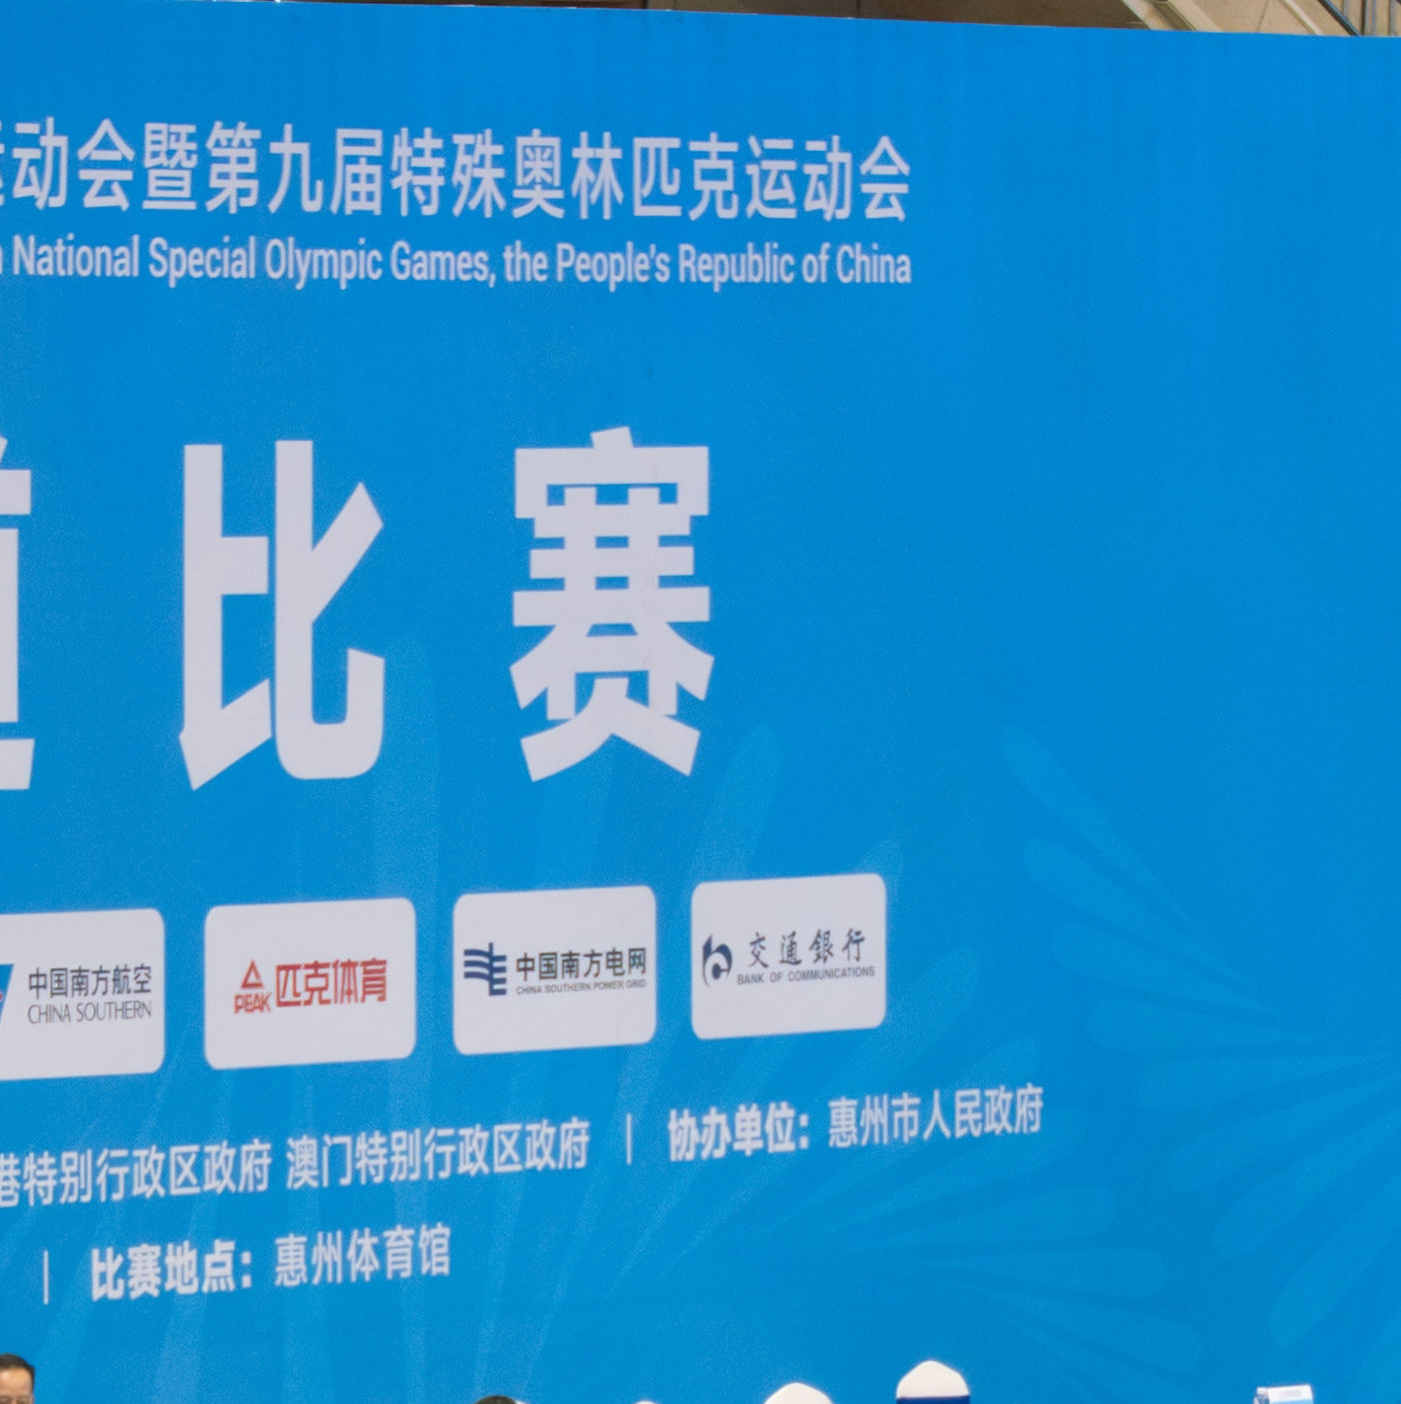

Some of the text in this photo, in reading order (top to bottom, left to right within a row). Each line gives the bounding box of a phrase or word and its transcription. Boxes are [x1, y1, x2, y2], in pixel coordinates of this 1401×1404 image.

[13, 233, 139, 277] National
[149, 236, 256, 288] Special
[264, 236, 382, 290] Olympic
[391, 240, 496, 288] Games,
[503, 240, 548, 282] the
[556, 241, 671, 292] People's
[679, 242, 795, 292] Republic
[802, 243, 831, 283] of
[837, 243, 911, 283] China
[29, 964, 151, 999] 中国南方航空
[516, 948, 646, 981] 中国南方电网
[737, 966, 876, 985] BANK OF COMMUNICATIONS
[276, 958, 387, 1007] 匹克体育
[516, 984, 542, 995] CHINA
[544, 983, 591, 994] SOUTHERN
[593, 981, 624, 992] POWER
[28, 1000, 151, 1024] CHINA SOUTHERN
[235, 993, 270, 1013] PEAK
[286, 1116, 590, 1189] 澳门特别行政区政府
[829, 1083, 1043, 1148] 惠州市人民政府
[275, 1222, 451, 1287] 惠州体育馆
